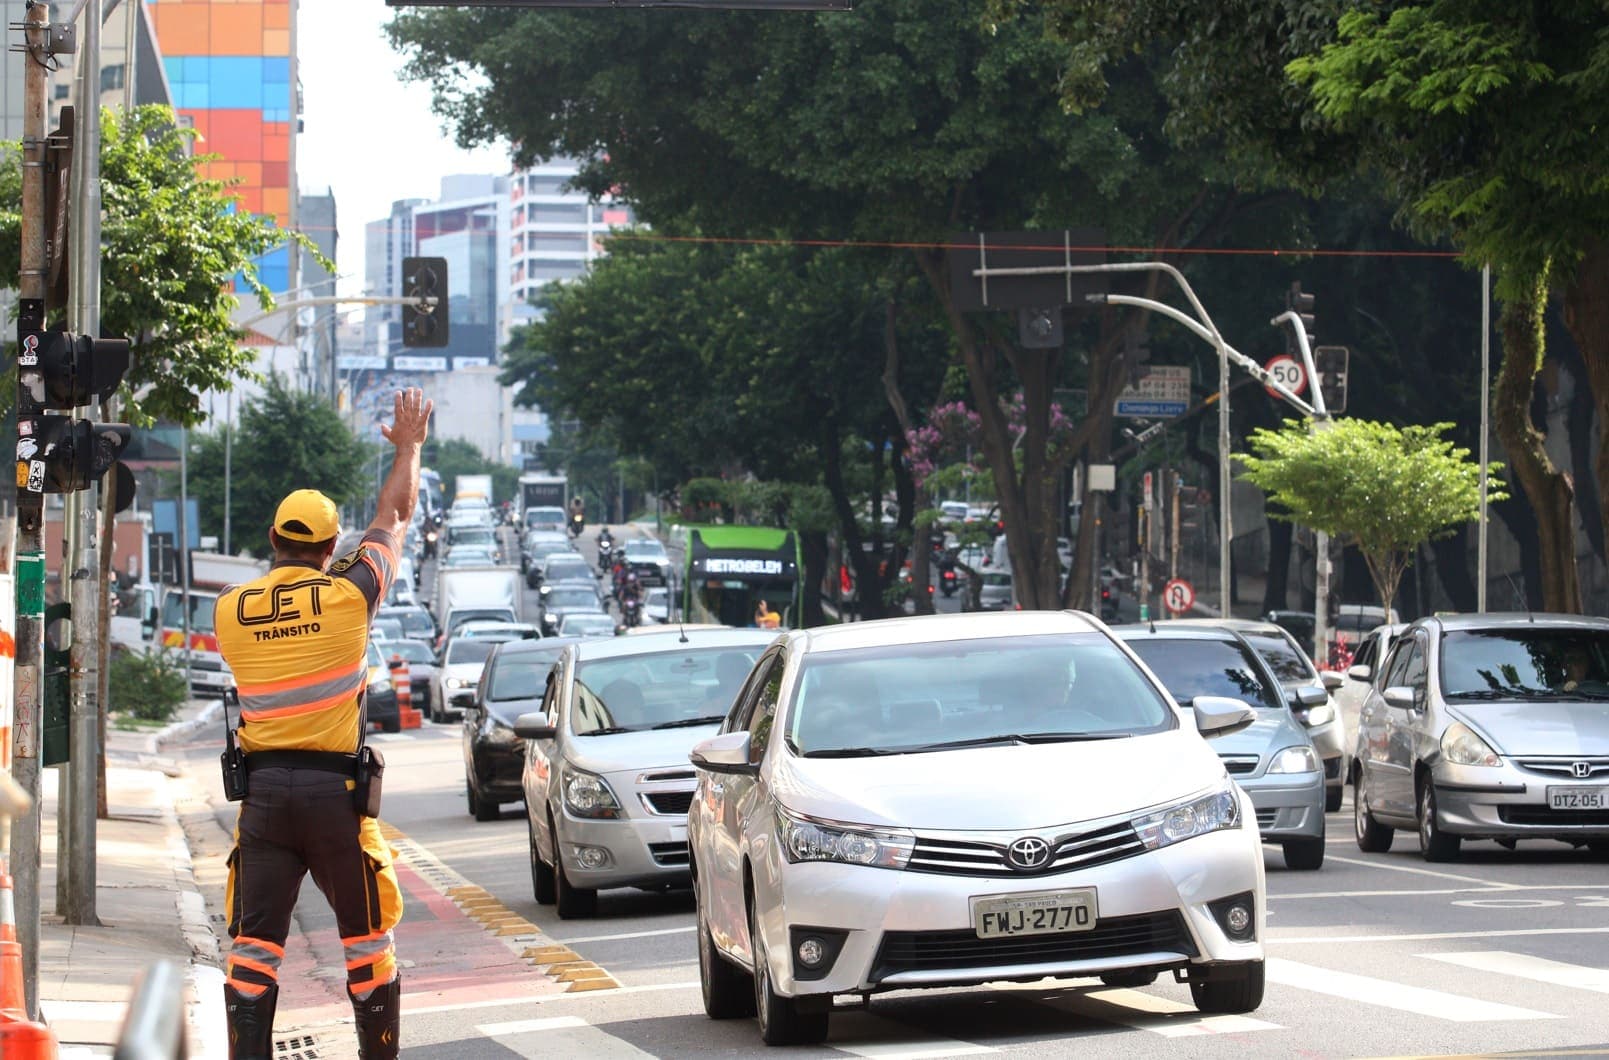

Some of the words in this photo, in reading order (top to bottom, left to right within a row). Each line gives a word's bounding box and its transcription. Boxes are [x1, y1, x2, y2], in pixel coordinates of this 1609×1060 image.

[1274, 366, 1299, 384] 50
[237, 578, 332, 626] CET
[254, 622, 321, 642] TRÂNSITO
